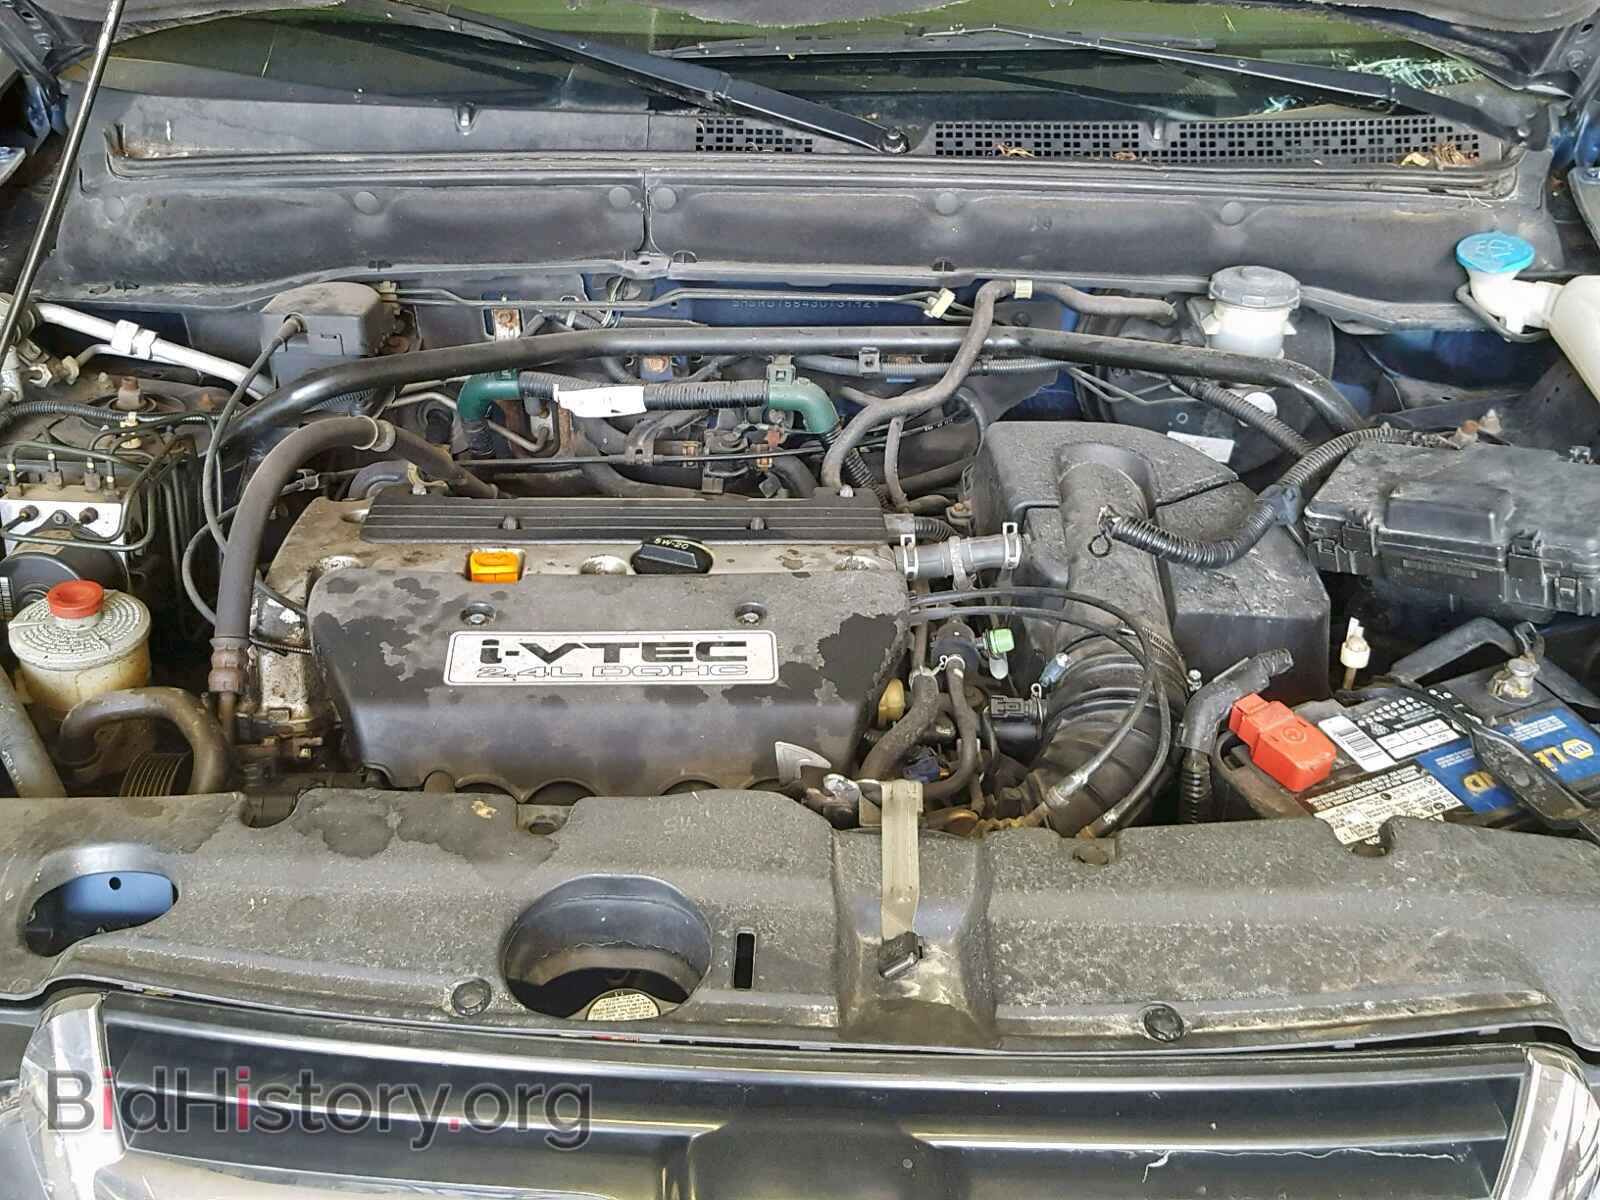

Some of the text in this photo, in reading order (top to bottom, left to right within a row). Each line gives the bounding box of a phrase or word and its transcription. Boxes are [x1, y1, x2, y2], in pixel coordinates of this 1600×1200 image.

[479, 638, 748, 665] i-VTEC
[476, 664, 749, 680] 2.4L DOHC
